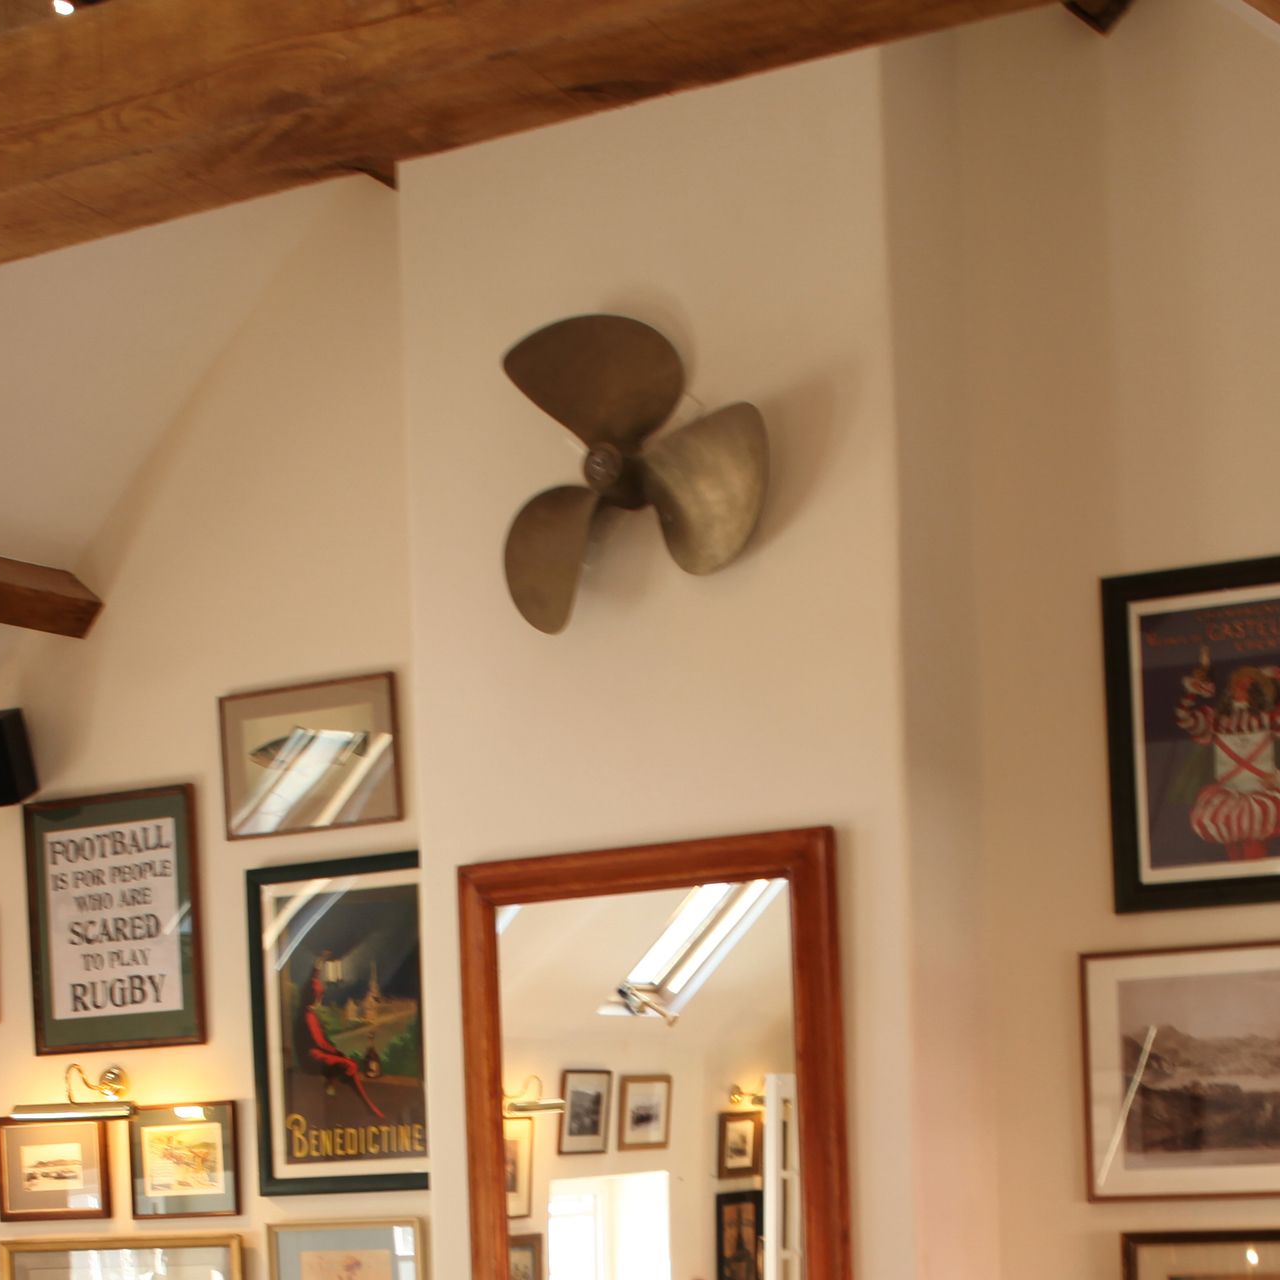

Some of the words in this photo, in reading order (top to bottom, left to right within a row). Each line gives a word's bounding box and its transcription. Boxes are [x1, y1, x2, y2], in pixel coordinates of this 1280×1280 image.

[50, 825, 171, 865] FOOTBALL
[51, 873, 69, 891] IS
[72, 869, 106, 888] FOR
[109, 860, 172, 884] PEOPLE
[73, 892, 113, 911] WHO
[119, 887, 152, 907] ARE
[68, 914, 161, 945] SCARED
[81, 953, 105, 971] TO
[108, 948, 151, 968] PLAY
[70, 974, 167, 1012] RUGBY
